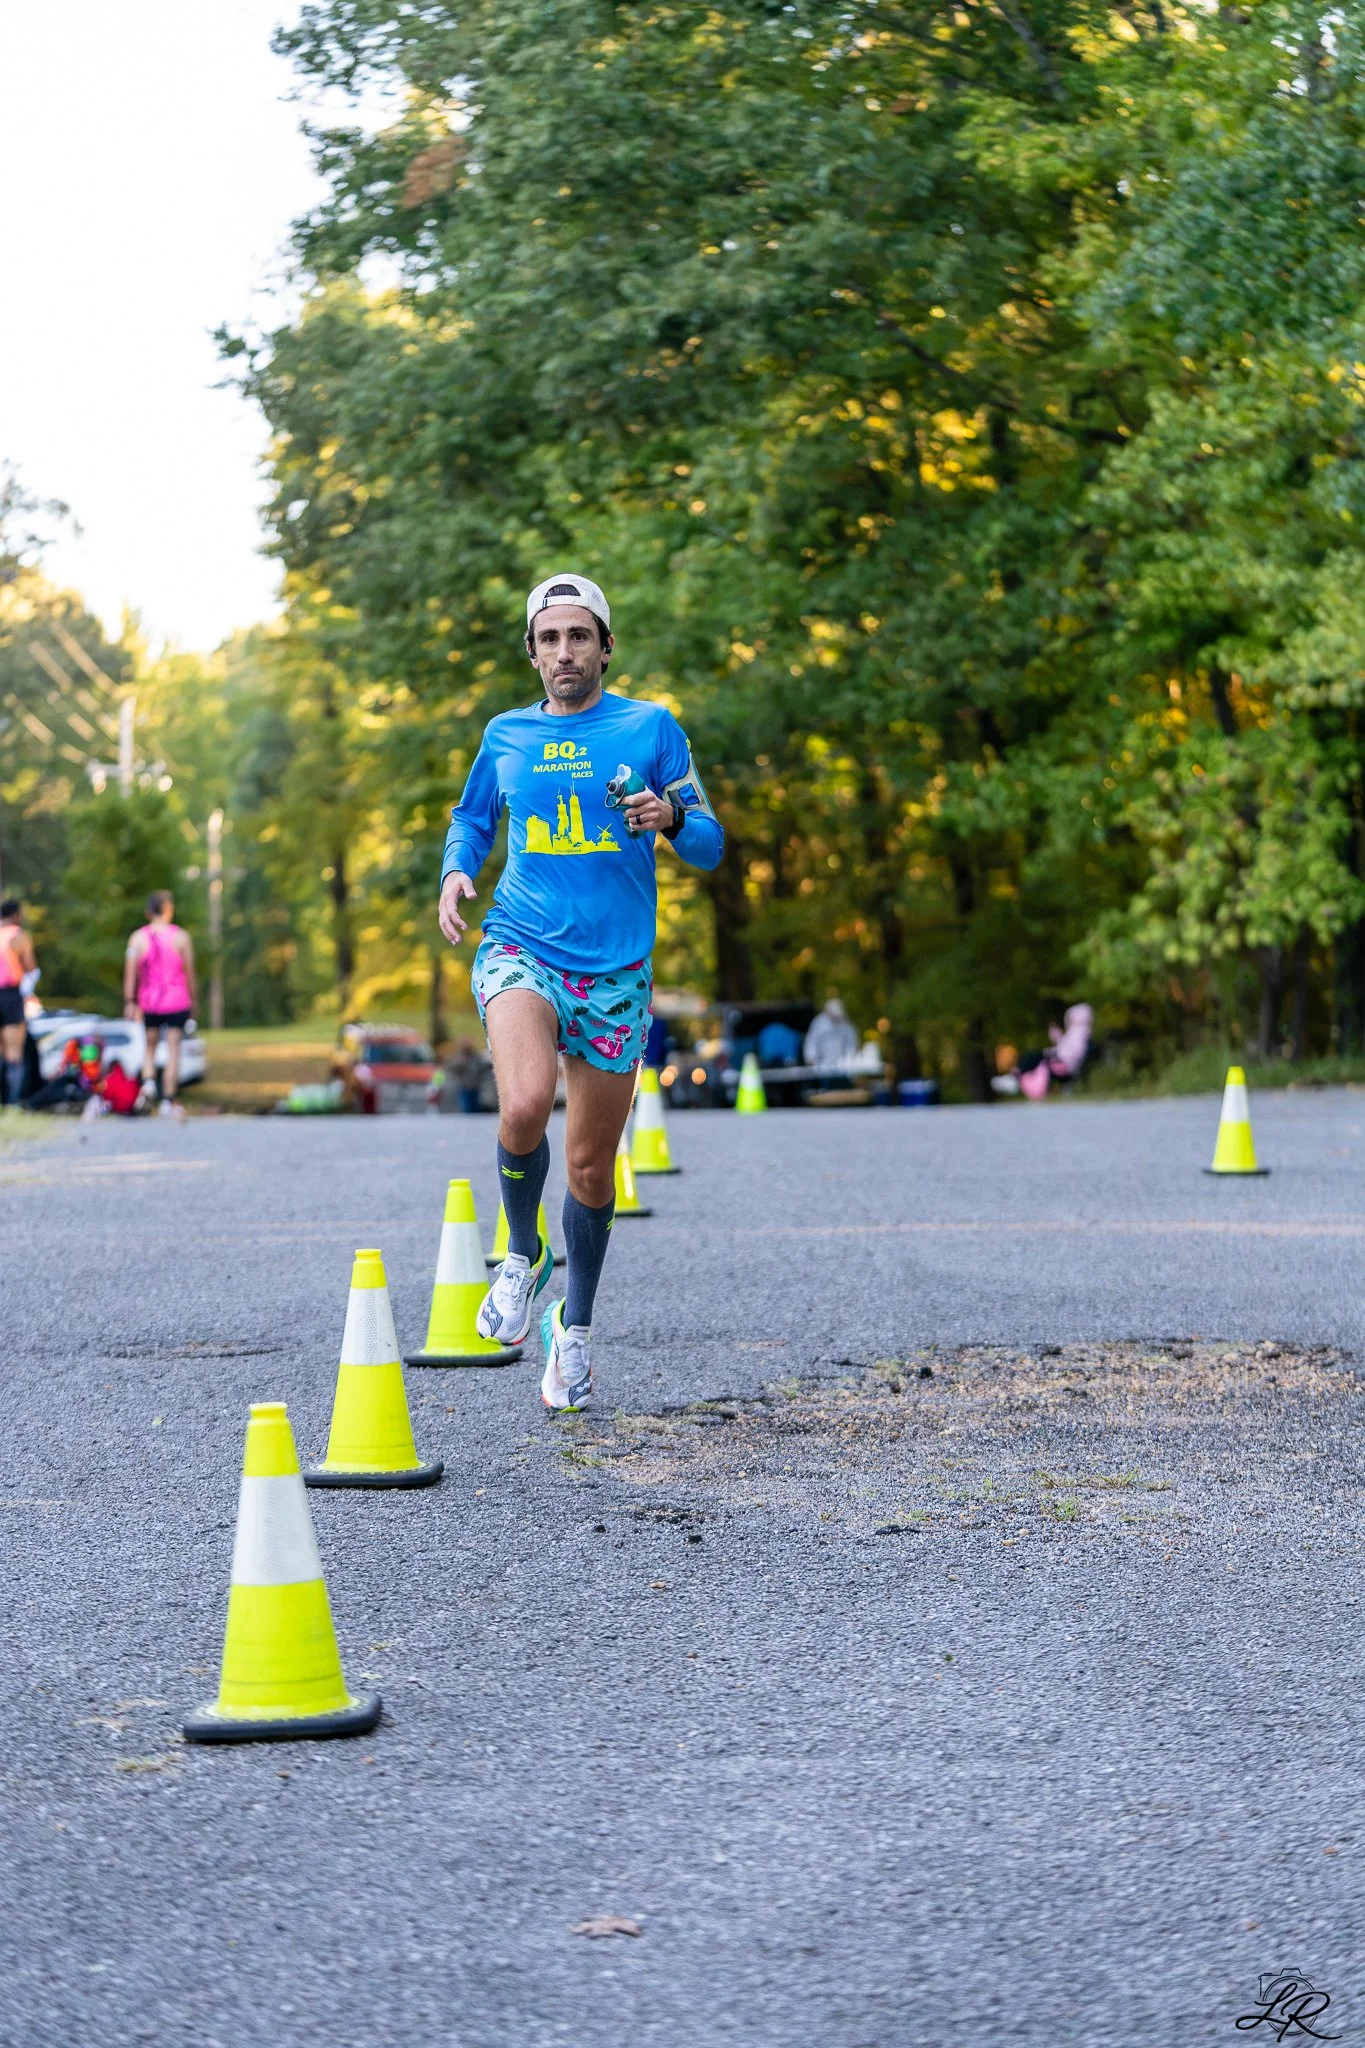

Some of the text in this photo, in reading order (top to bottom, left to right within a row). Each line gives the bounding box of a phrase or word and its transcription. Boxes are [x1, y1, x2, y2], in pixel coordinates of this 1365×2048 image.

[543, 741, 587, 760] BQ.2
[533, 761, 591, 773] MARATHON
[571, 771, 594, 779] RACES
